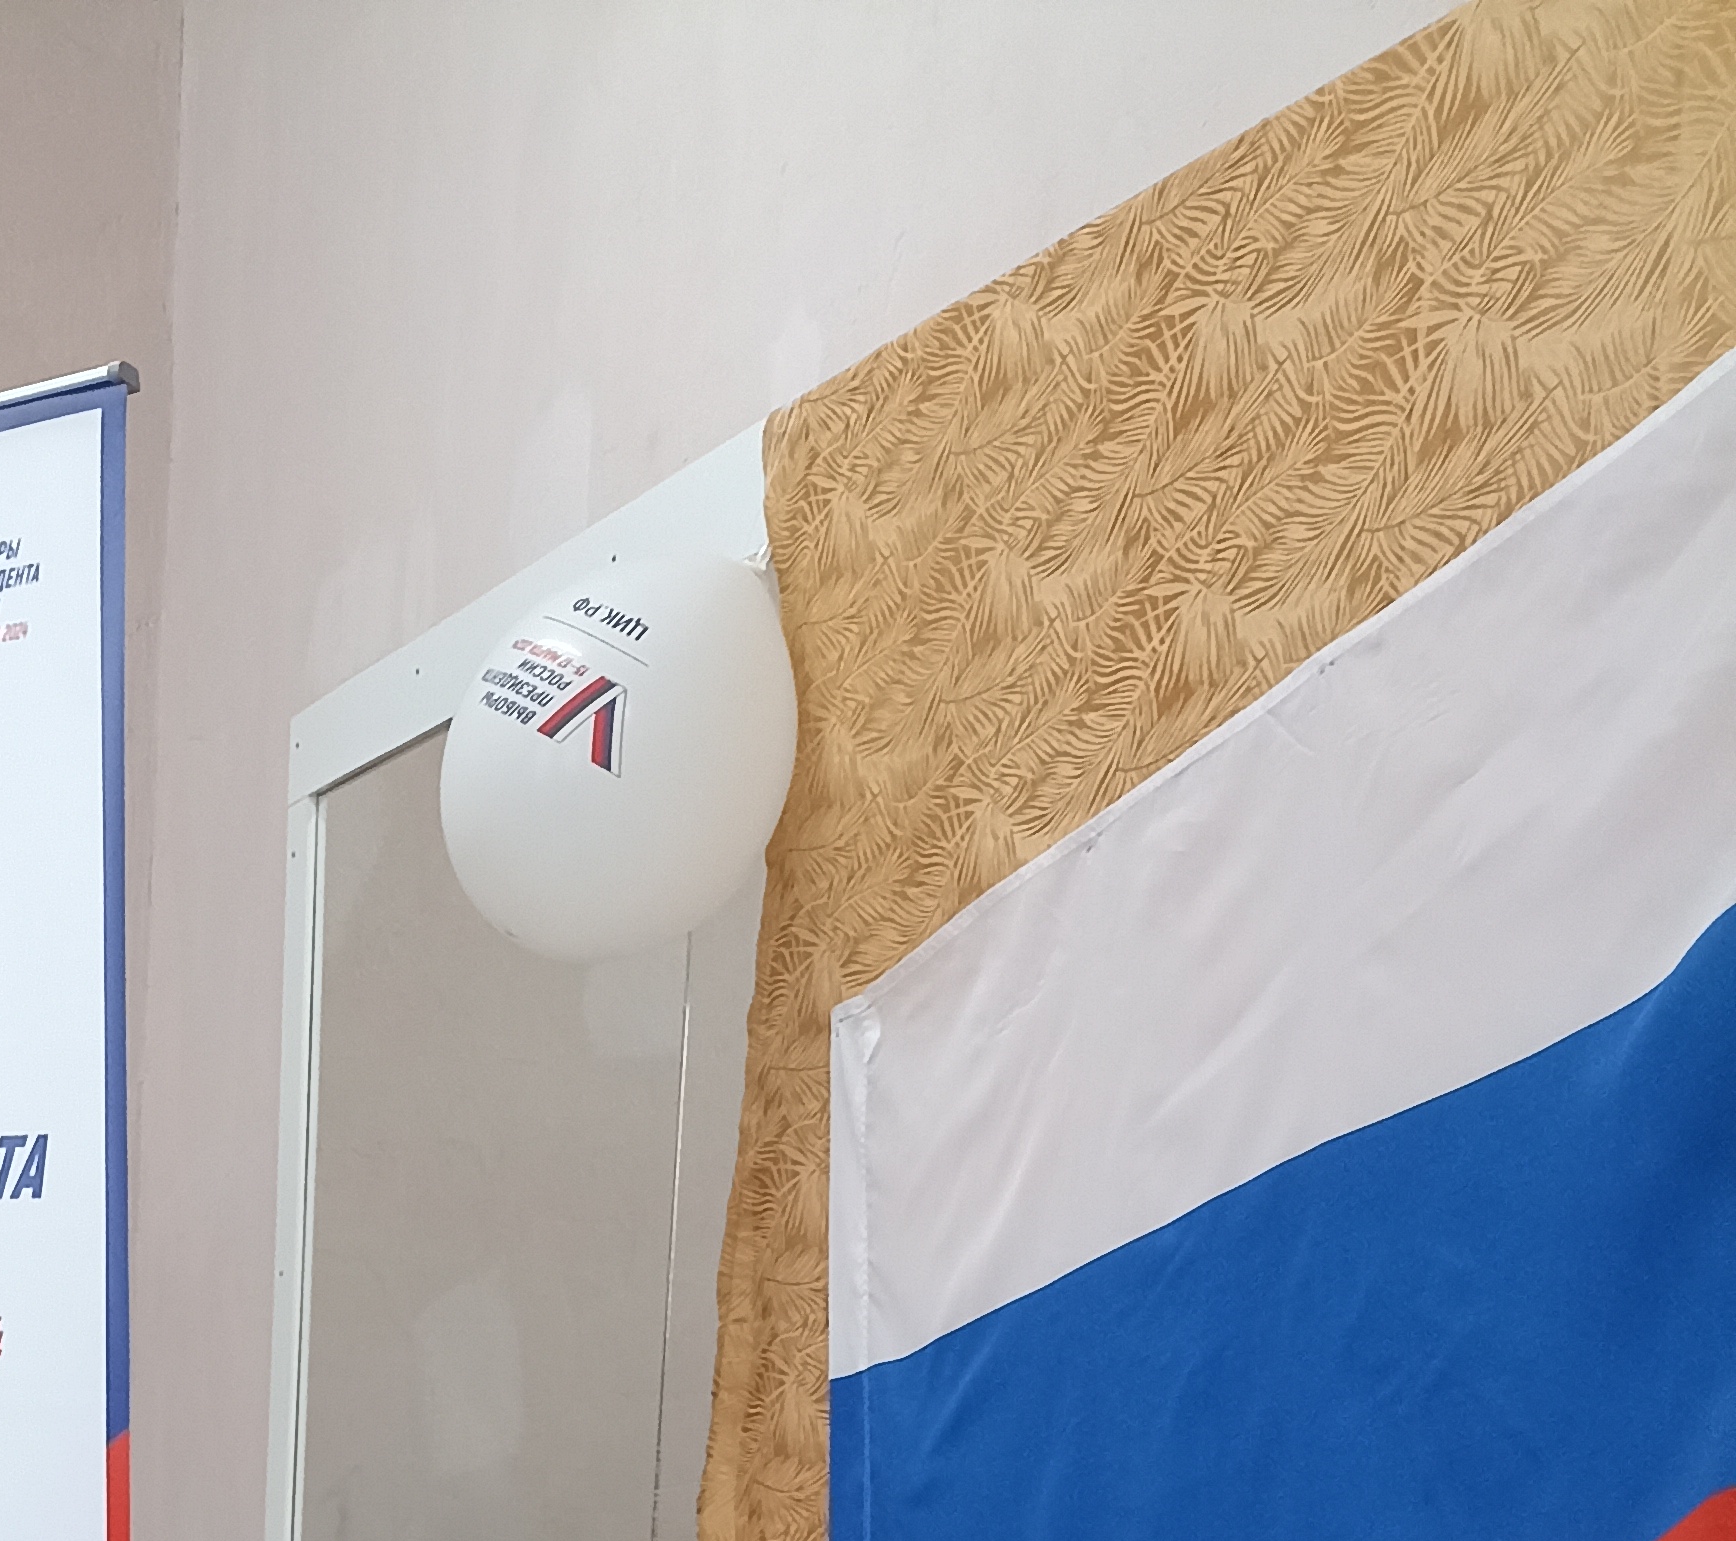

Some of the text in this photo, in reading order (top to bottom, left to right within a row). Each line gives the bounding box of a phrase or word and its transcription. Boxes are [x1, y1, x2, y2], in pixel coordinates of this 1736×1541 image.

[573, 597, 649, 641] ЦИК.РФ
[517, 657, 572, 692] РОССИИ
[479, 690, 537, 726] ВЫБОРЫ
